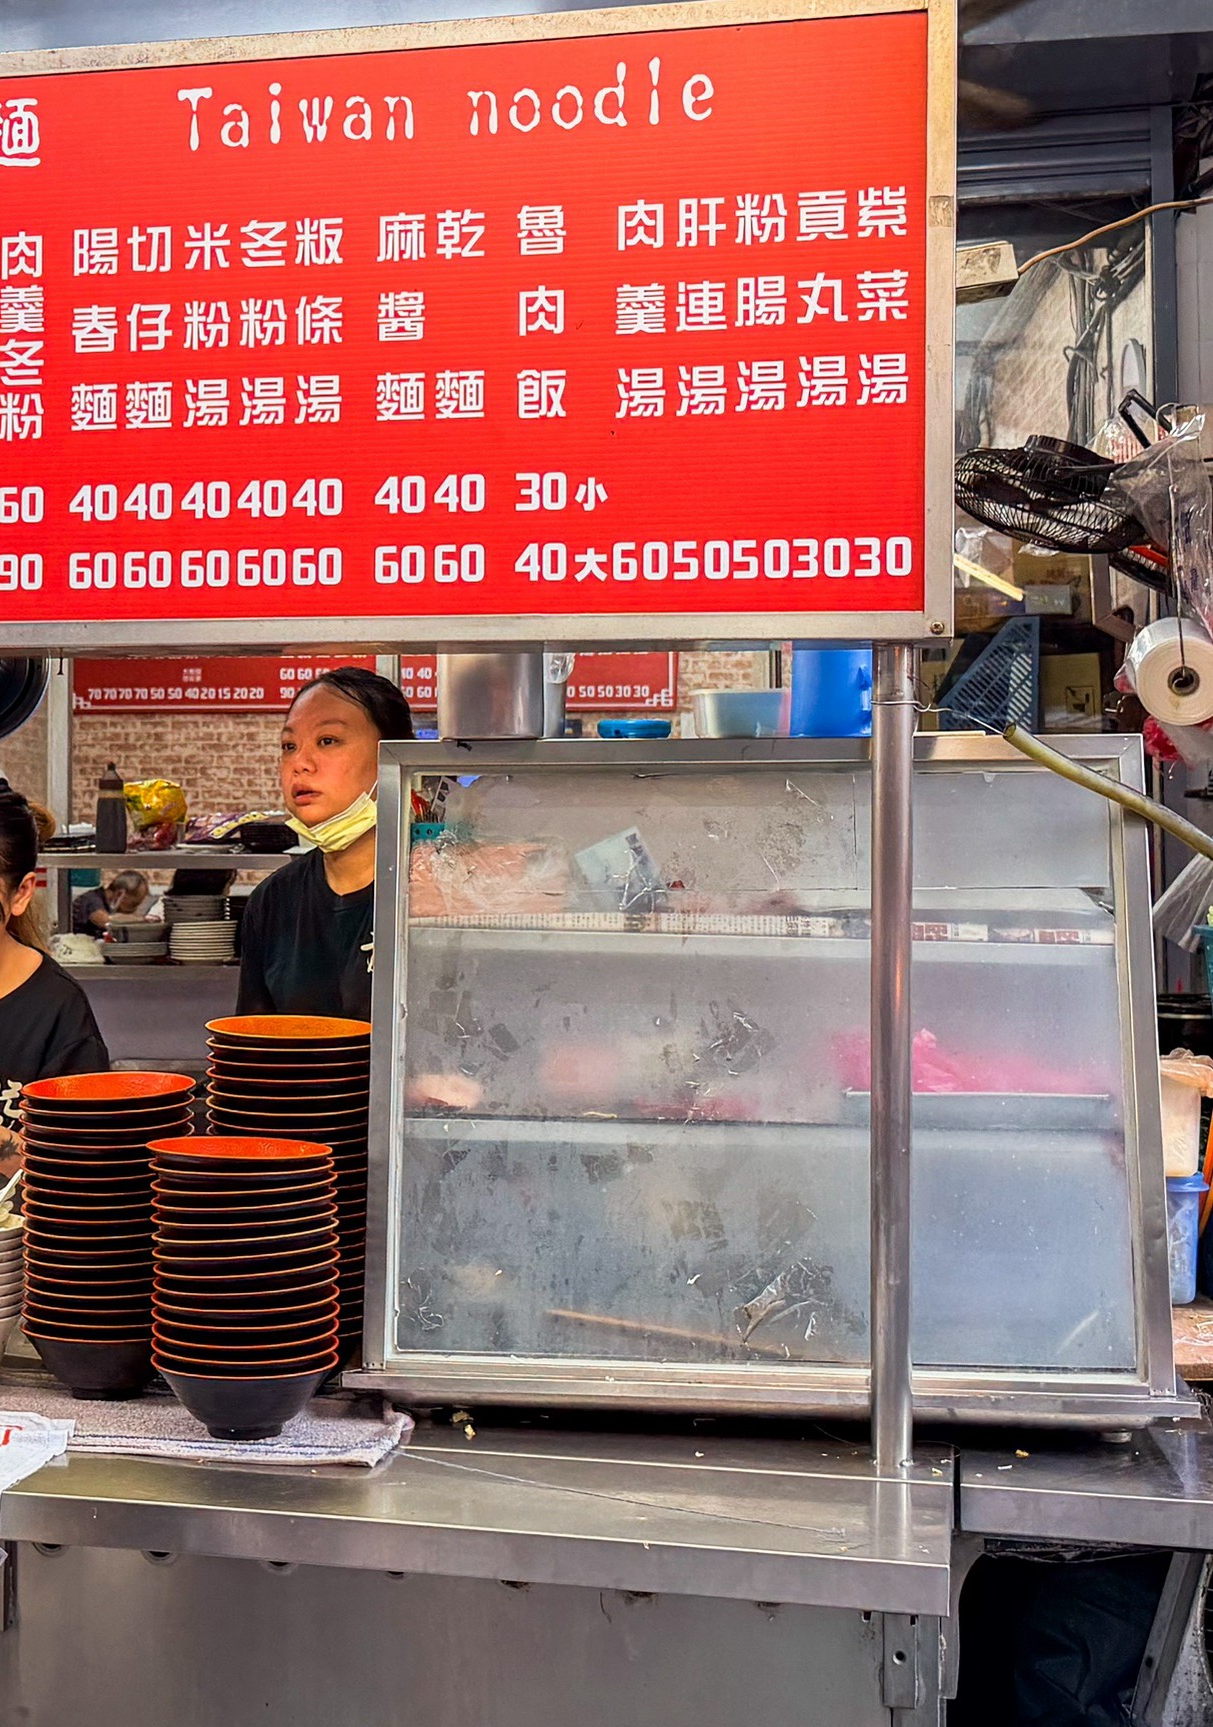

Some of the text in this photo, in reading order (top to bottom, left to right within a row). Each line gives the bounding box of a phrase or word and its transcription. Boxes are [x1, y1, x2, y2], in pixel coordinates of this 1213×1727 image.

[176, 56, 715, 152] Taiwan noodle
[69, 478, 343, 522] 40 40 40 40 40
[374, 473, 485, 515] 40 40
[515, 471, 567, 511] 30
[69, 547, 342, 590] 60 60 60 60 60
[374, 543, 485, 584] 60 60
[514, 542, 567, 582] 40
[612, 536, 912, 581] 60 50 50 30 30
